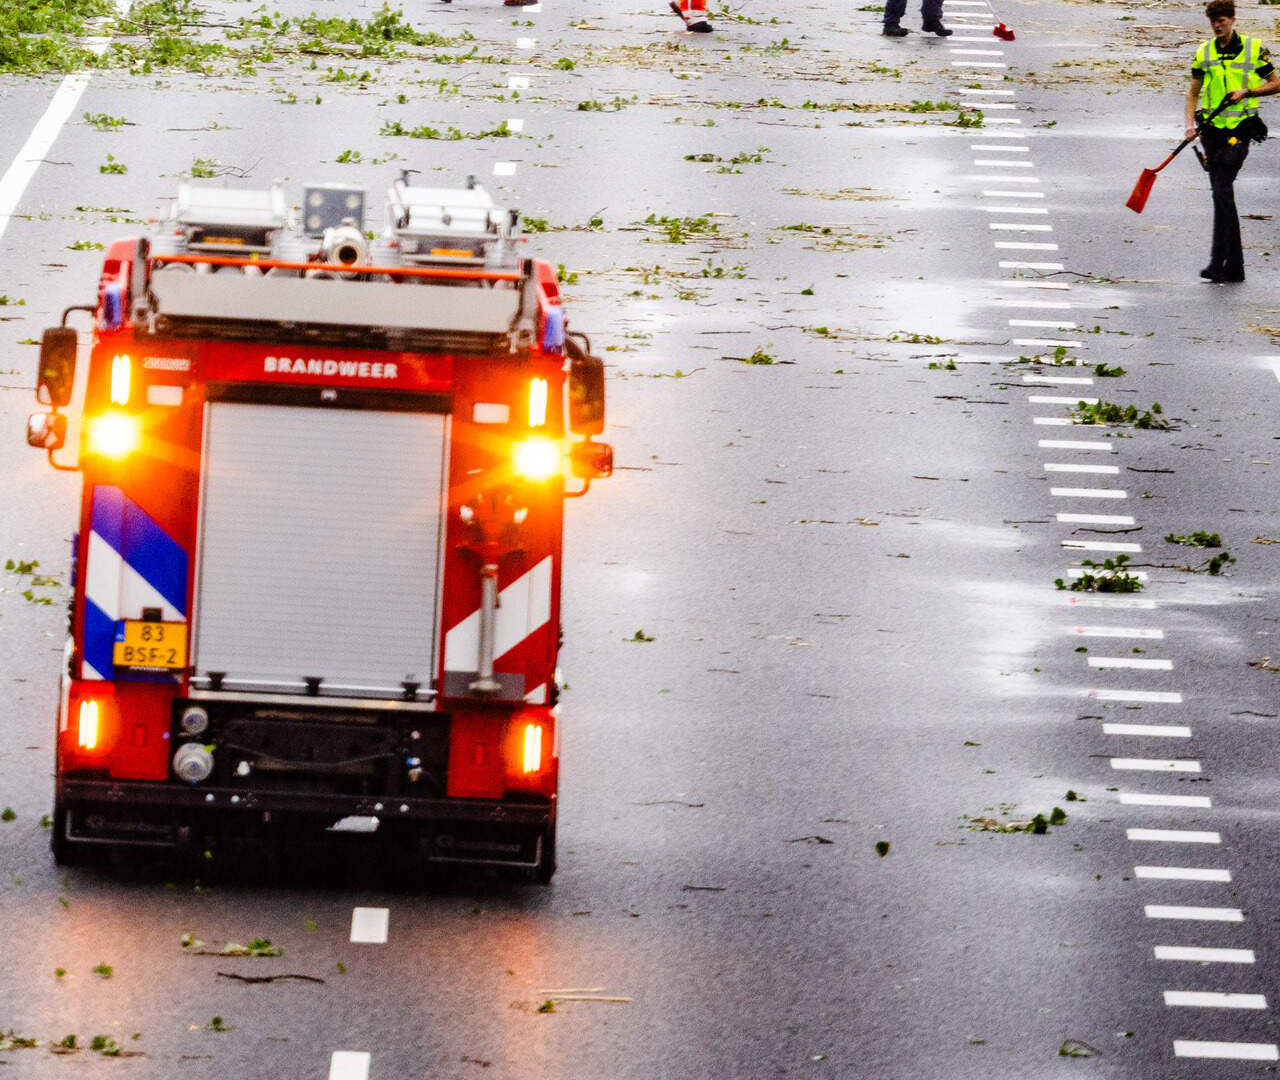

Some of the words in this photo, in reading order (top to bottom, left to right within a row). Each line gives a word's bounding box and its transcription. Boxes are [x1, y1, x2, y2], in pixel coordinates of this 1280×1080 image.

[263, 356, 399, 379] BRANDWEER
[141, 625, 165, 642] 83
[123, 646, 177, 665] BSF-2
